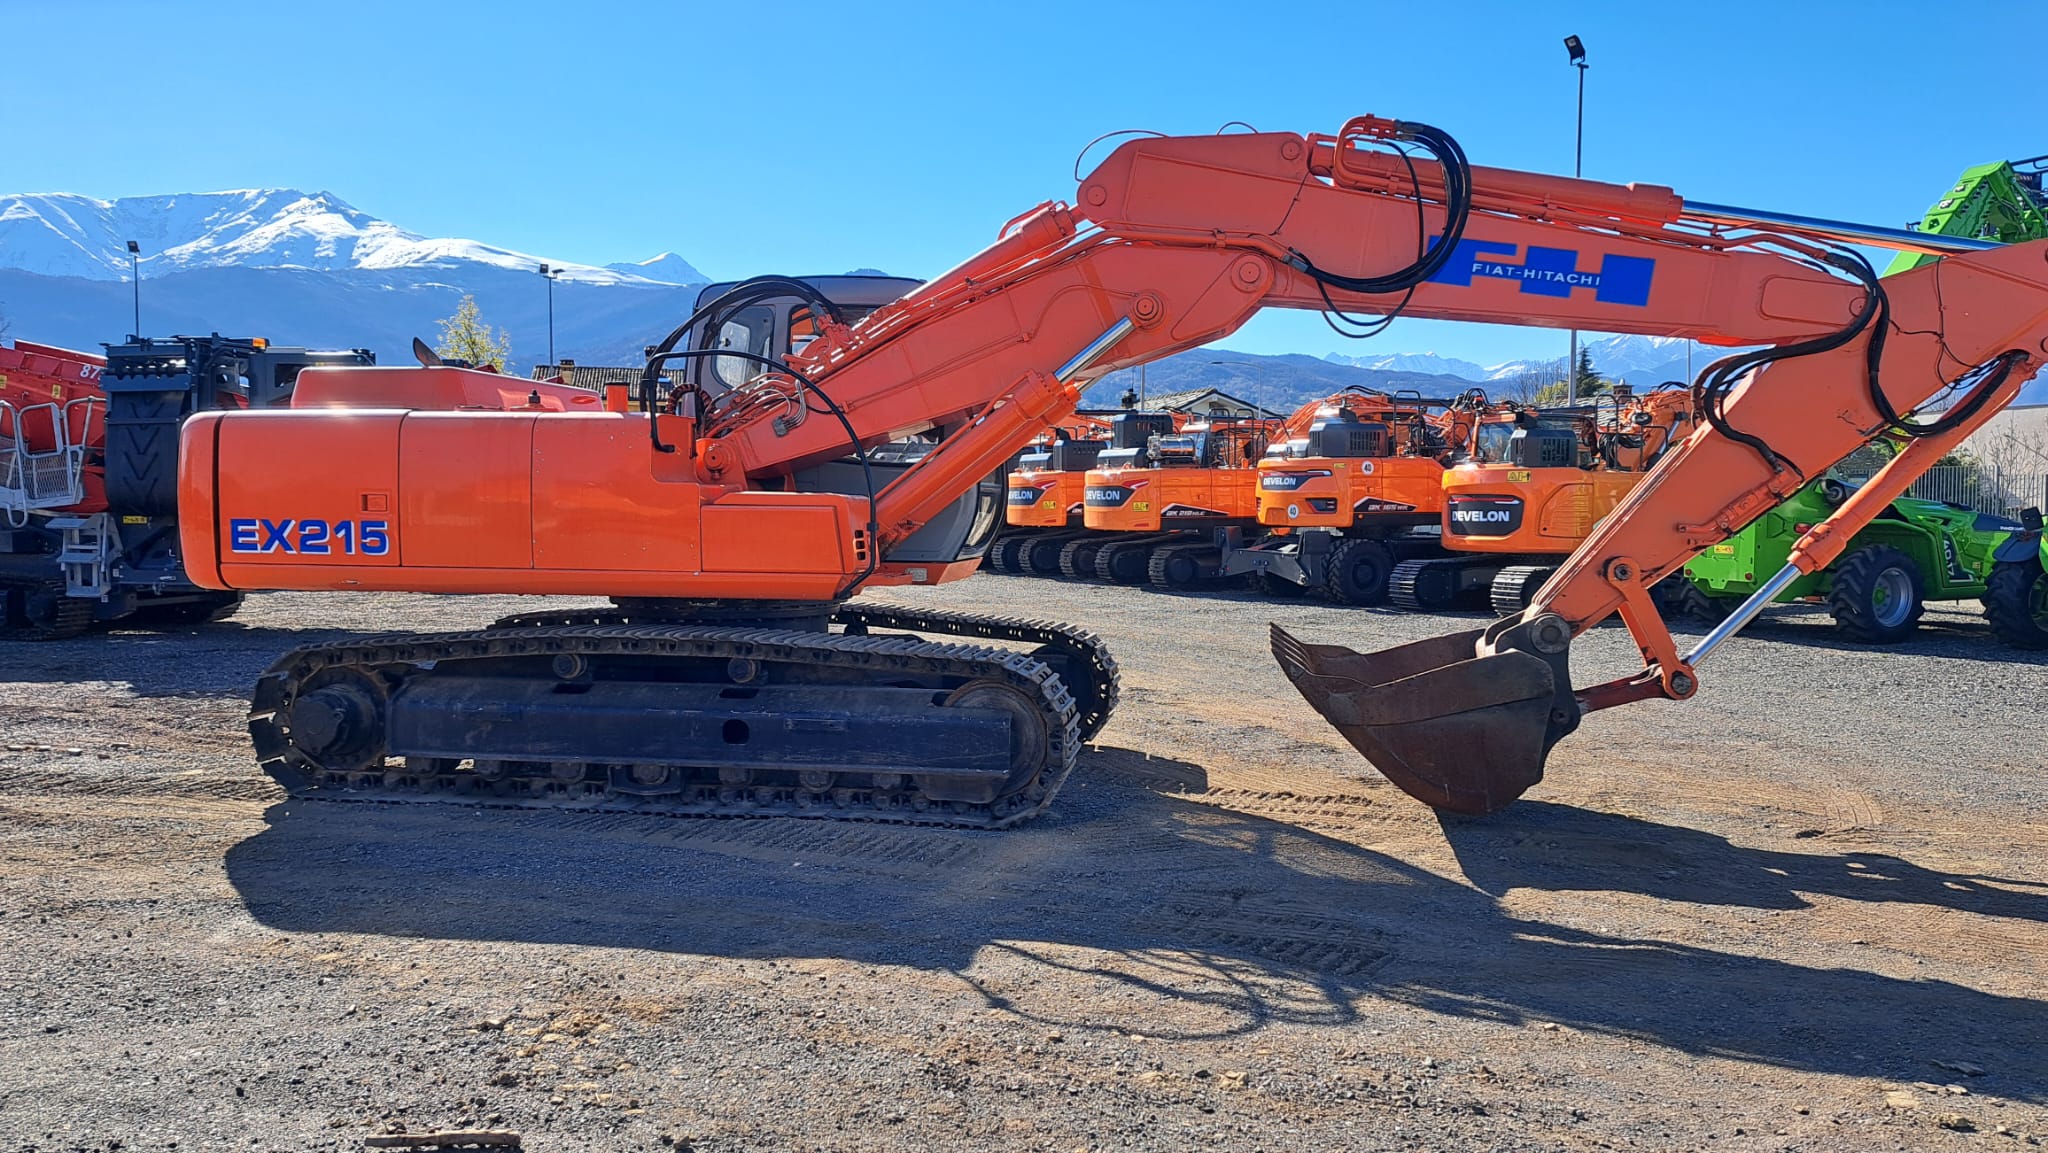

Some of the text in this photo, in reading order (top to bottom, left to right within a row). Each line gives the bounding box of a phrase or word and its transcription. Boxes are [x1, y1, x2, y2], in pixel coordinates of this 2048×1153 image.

[1471, 263, 1601, 286] FIAT-HITACHI
[80, 364, 101, 381] 87
[1263, 477, 1297, 486] DEVELON
[1085, 490, 1120, 501] DEVELON
[1452, 510, 1510, 522] DEVELON
[230, 518, 390, 556] EX215
